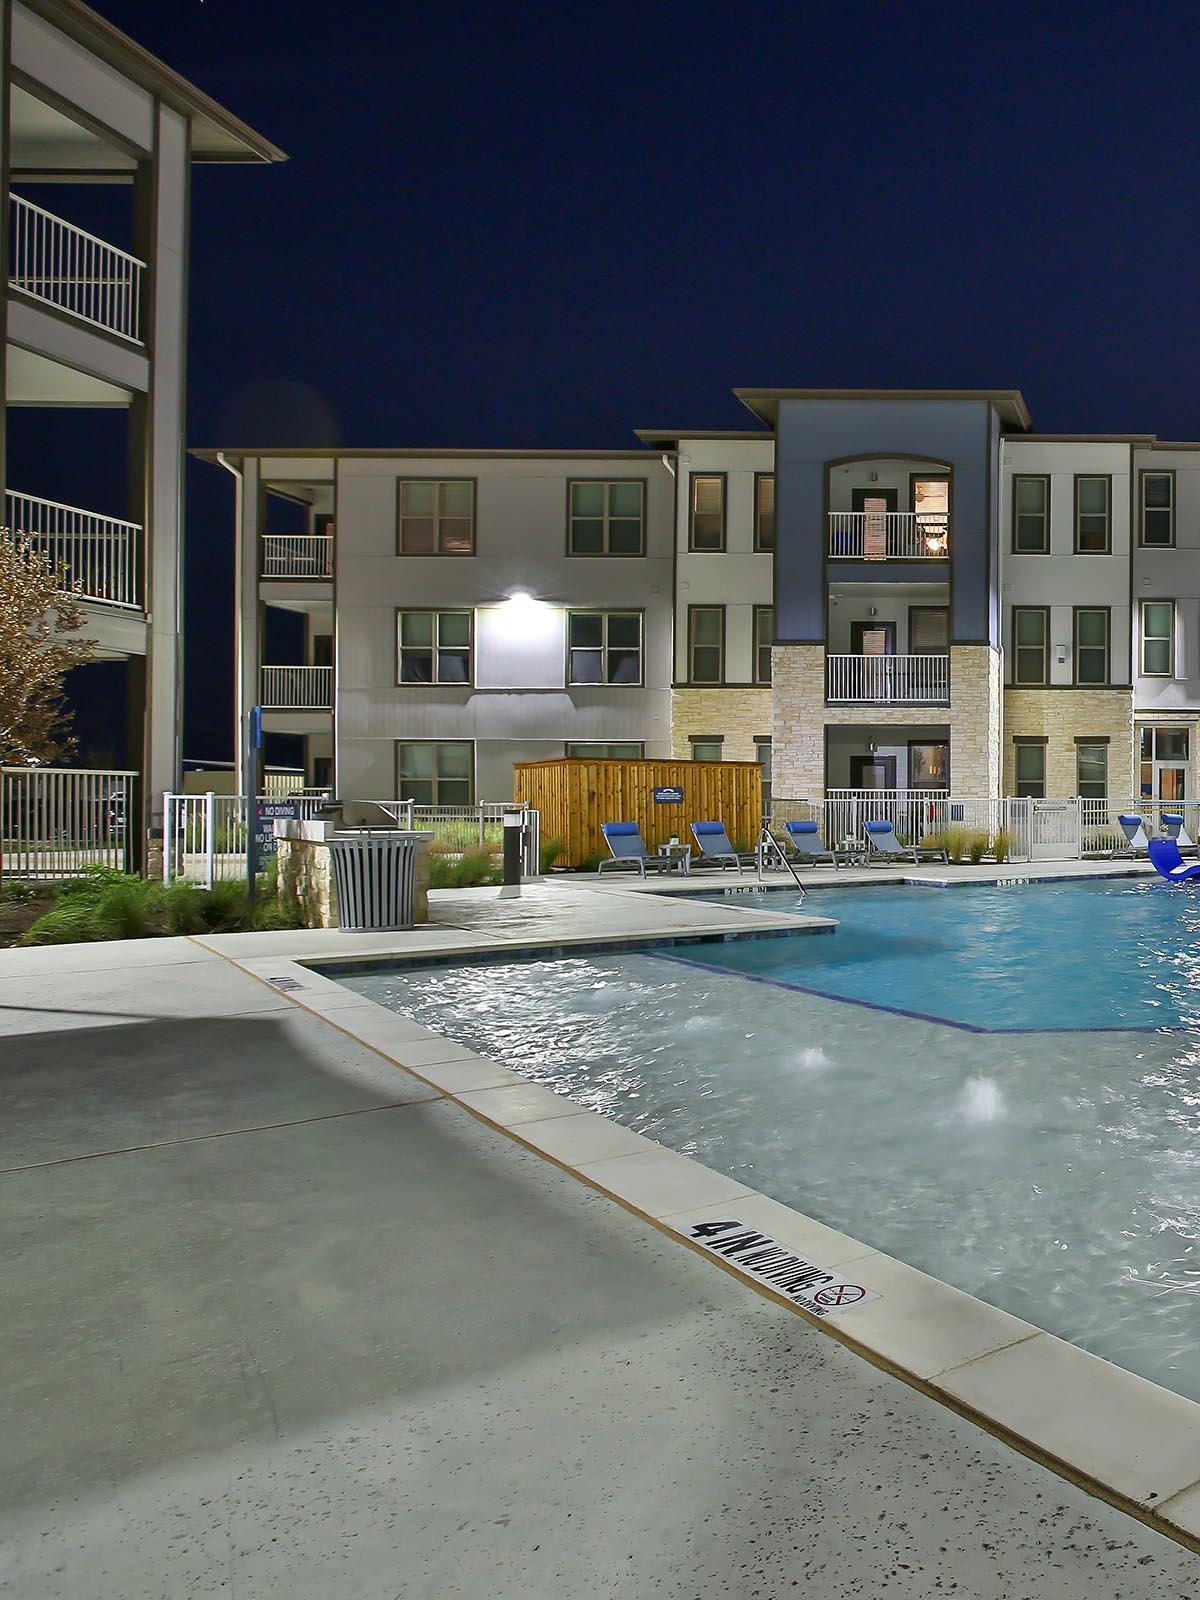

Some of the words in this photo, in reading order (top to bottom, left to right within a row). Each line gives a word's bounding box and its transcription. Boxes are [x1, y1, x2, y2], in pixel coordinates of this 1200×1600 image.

[265, 806, 275, 816] NO
[275, 806, 295, 816] DIVING
[690, 1220, 743, 1238] 4
[704, 1230, 775, 1258] IN.
[733, 1246, 789, 1266] NO
[750, 1255, 834, 1294] DIVING
[802, 1299, 830, 1316] DIVING
